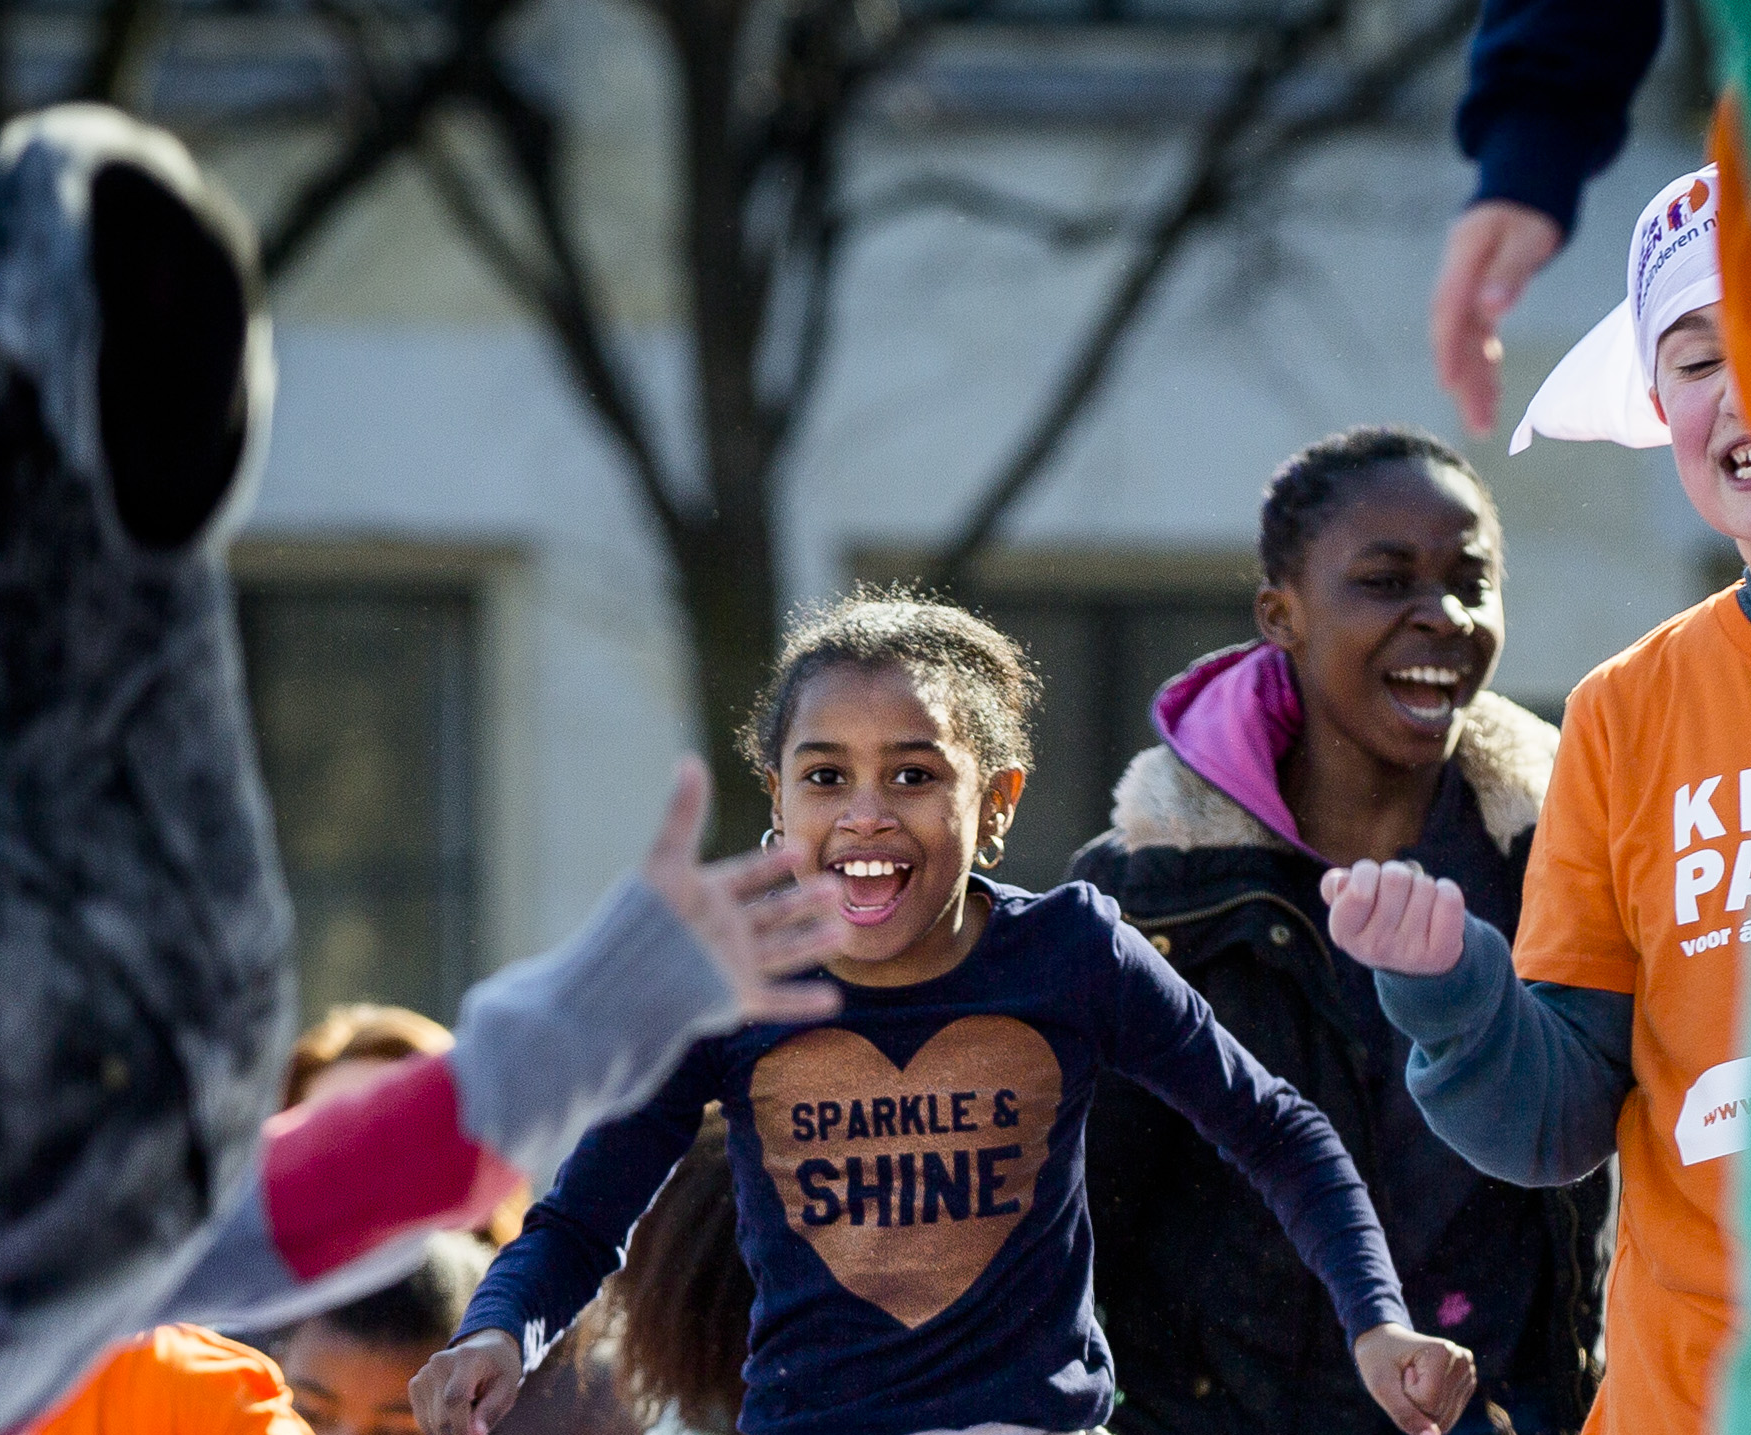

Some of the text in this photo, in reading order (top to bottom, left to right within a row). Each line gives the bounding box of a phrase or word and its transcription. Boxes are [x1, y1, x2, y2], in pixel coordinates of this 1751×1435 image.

[1679, 926, 1732, 958] voor
[791, 1088, 1020, 1142] SPARKLE &
[795, 1143, 1023, 1228] SHINE
